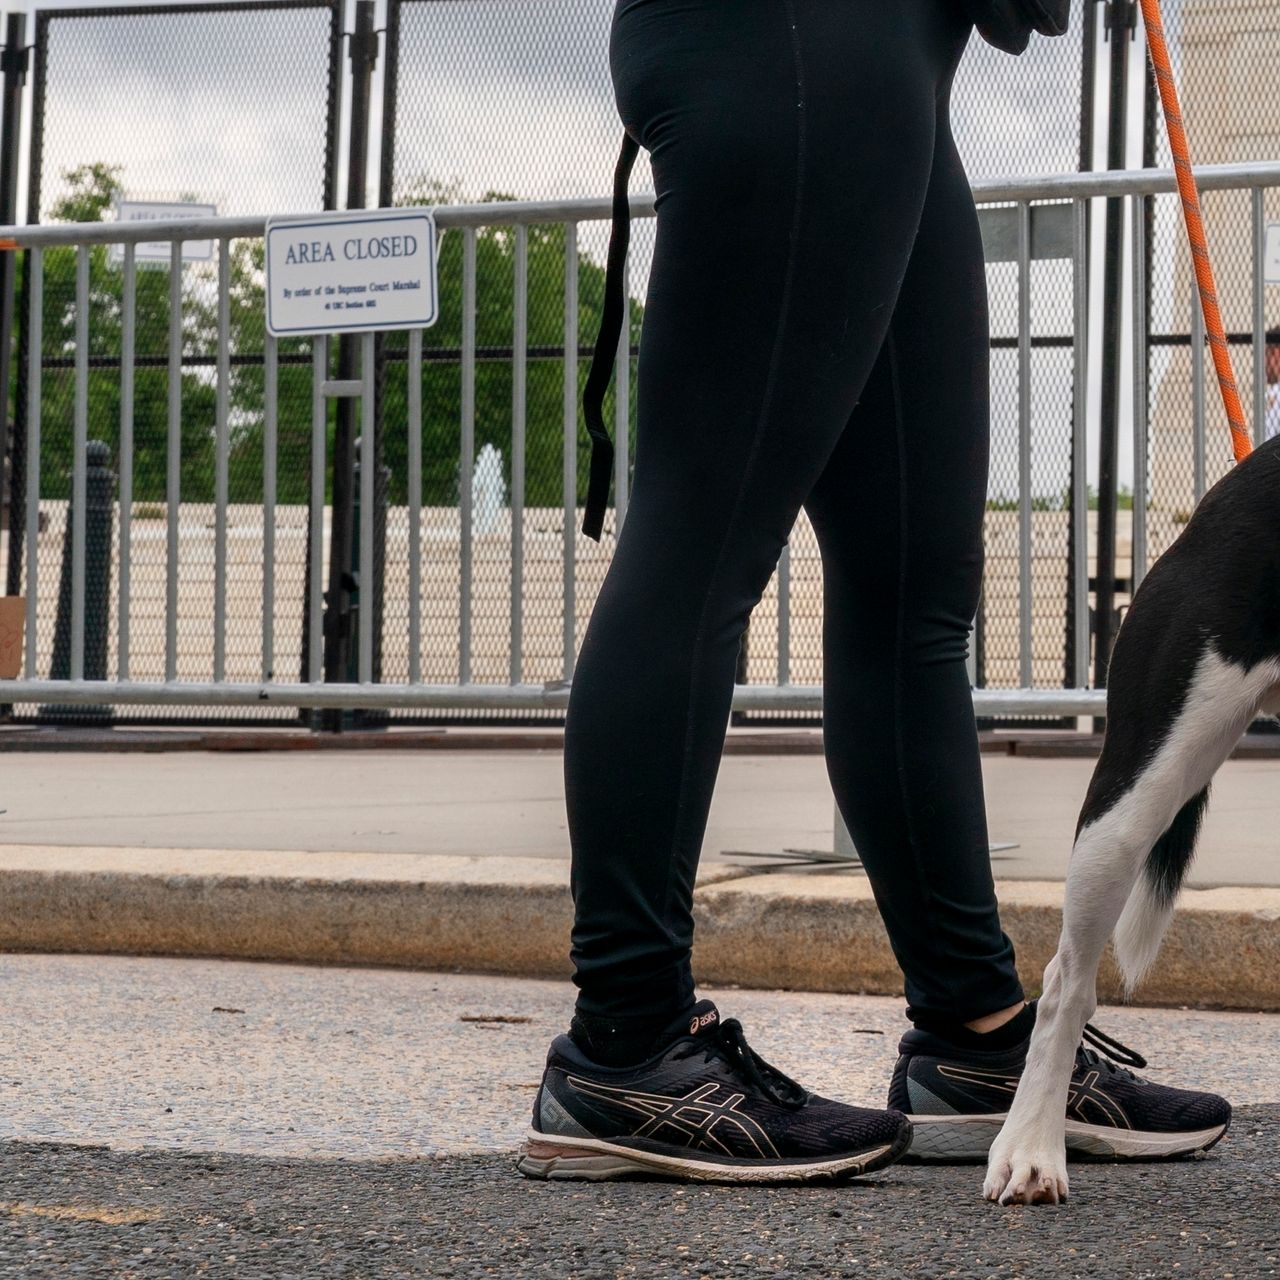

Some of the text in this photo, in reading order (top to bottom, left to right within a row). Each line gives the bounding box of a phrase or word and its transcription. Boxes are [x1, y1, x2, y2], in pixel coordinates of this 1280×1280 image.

[285, 235, 418, 265] AREA CLOSED
[369, 282, 389, 293] Court
